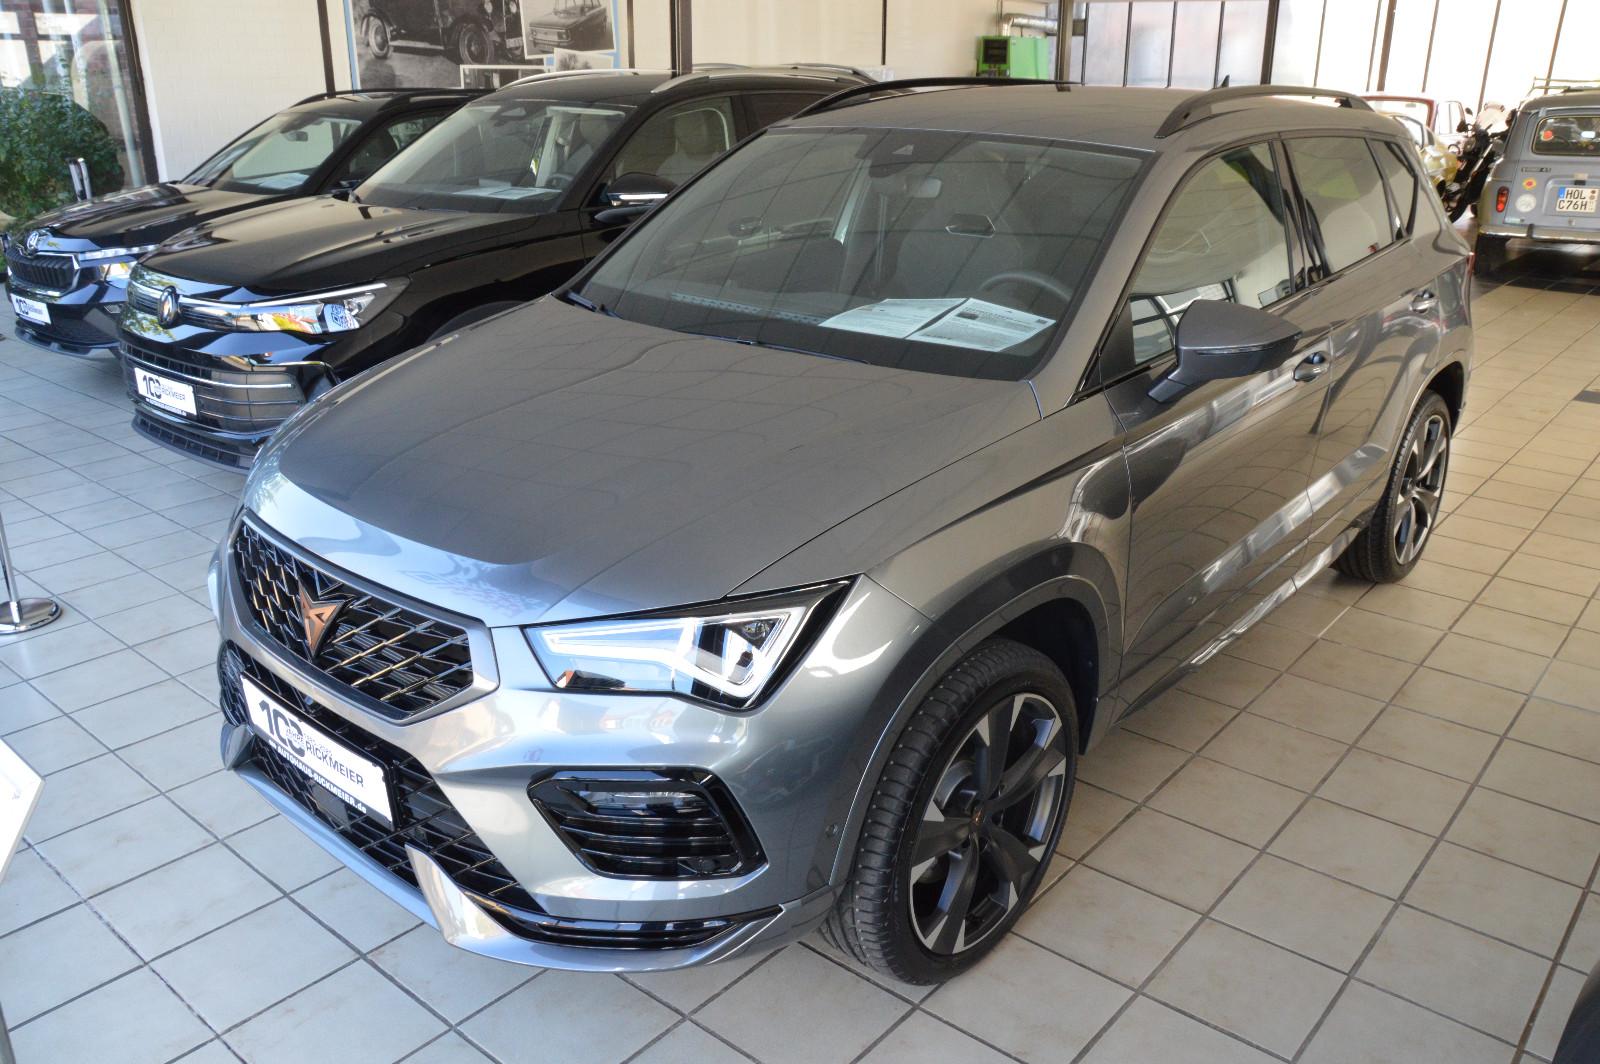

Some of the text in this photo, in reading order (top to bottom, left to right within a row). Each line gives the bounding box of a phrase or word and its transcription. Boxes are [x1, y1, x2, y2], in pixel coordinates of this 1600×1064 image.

[1558, 200, 1588, 210] C76H
[1565, 189, 1586, 200] HOL
[258, 699, 306, 758] 100
[305, 740, 365, 787] RICKMEIER
